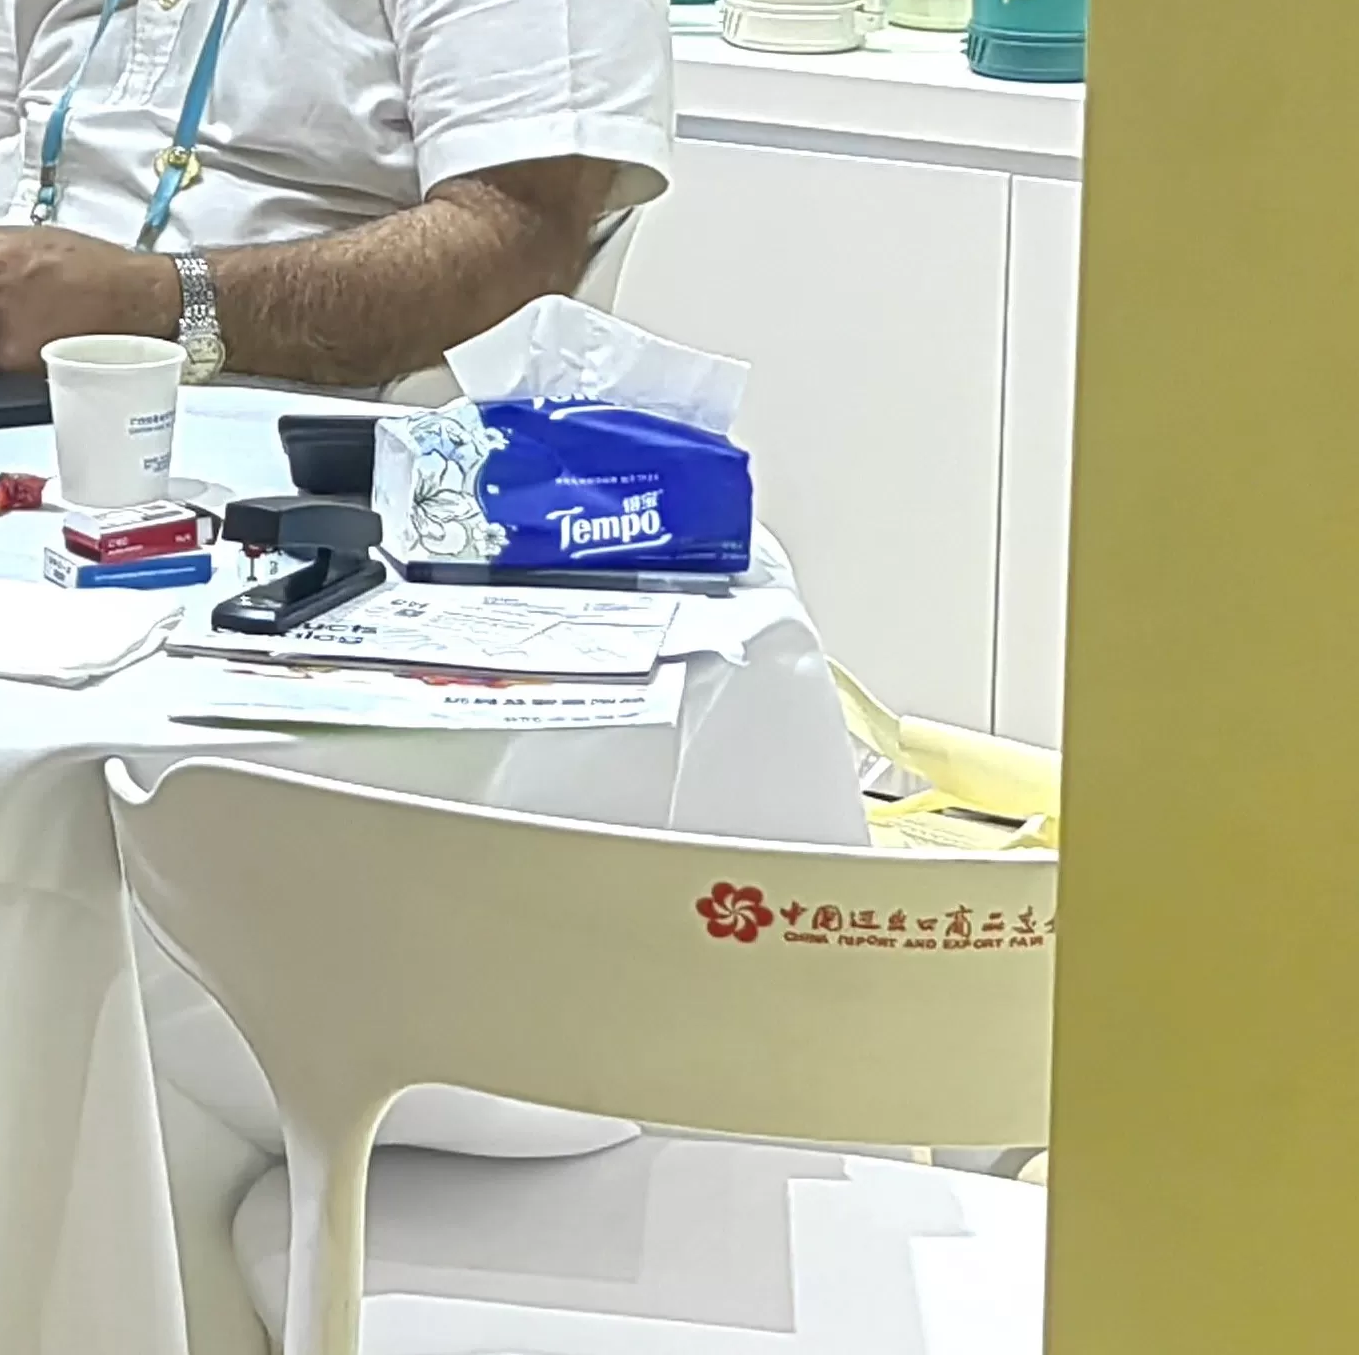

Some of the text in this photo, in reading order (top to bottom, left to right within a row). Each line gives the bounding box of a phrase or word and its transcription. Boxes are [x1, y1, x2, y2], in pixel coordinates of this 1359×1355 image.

[546, 505, 662, 550] Tempo
[903, 935, 938, 950] AND
[943, 934, 1005, 950] EXPORT
